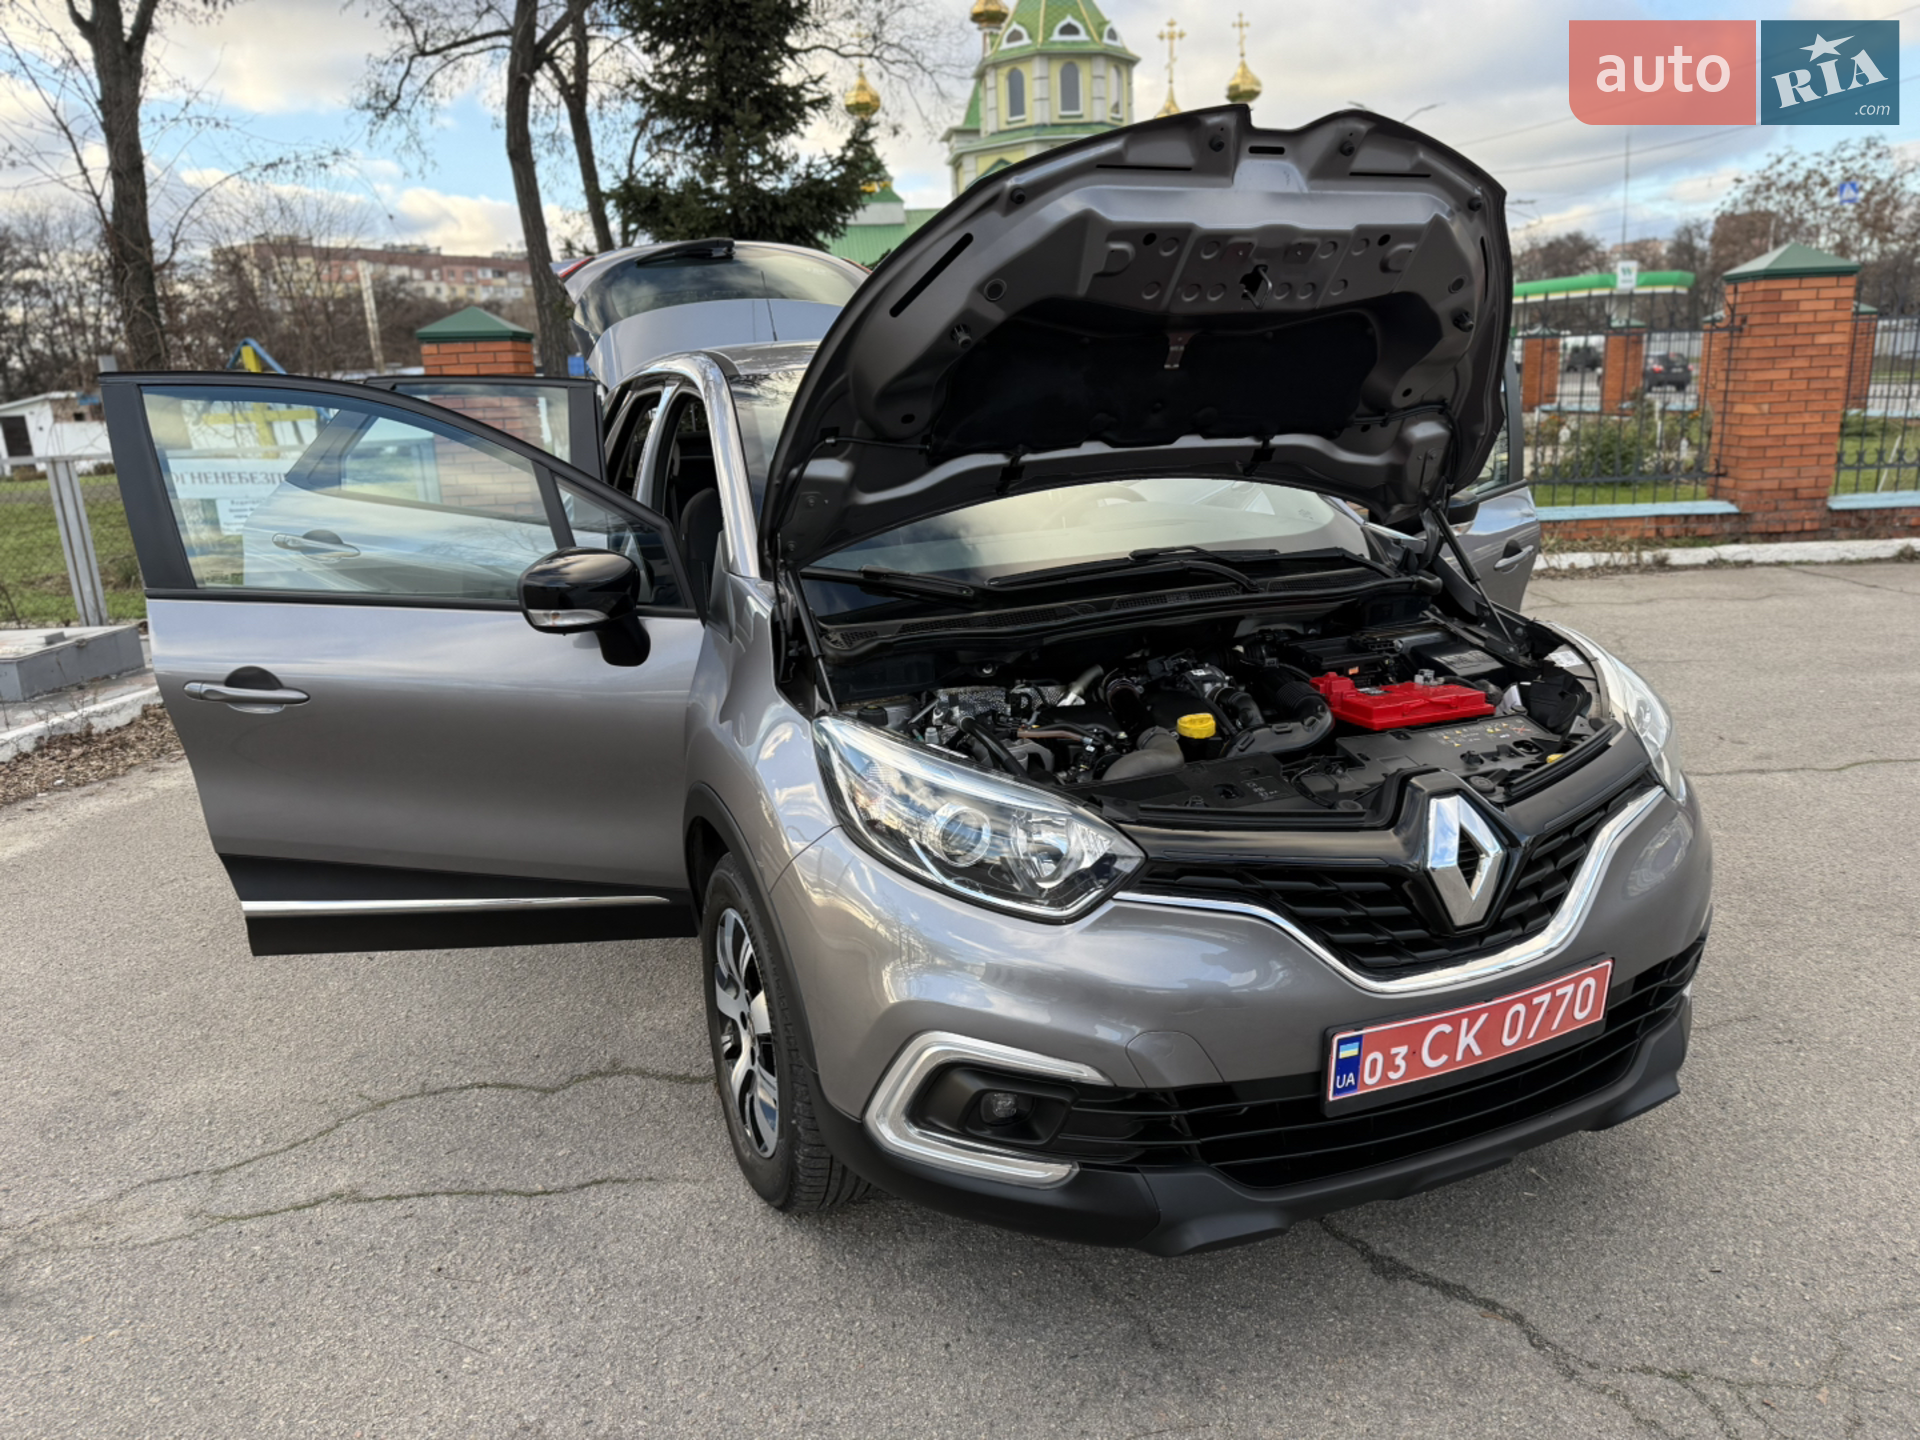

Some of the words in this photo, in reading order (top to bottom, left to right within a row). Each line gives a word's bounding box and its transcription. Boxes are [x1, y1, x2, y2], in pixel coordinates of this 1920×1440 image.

[1363, 1045, 1408, 1086] 03
[1420, 1012, 1489, 1068] CK
[1501, 976, 1597, 1047] 0770
[1336, 1074, 1356, 1089] UA
